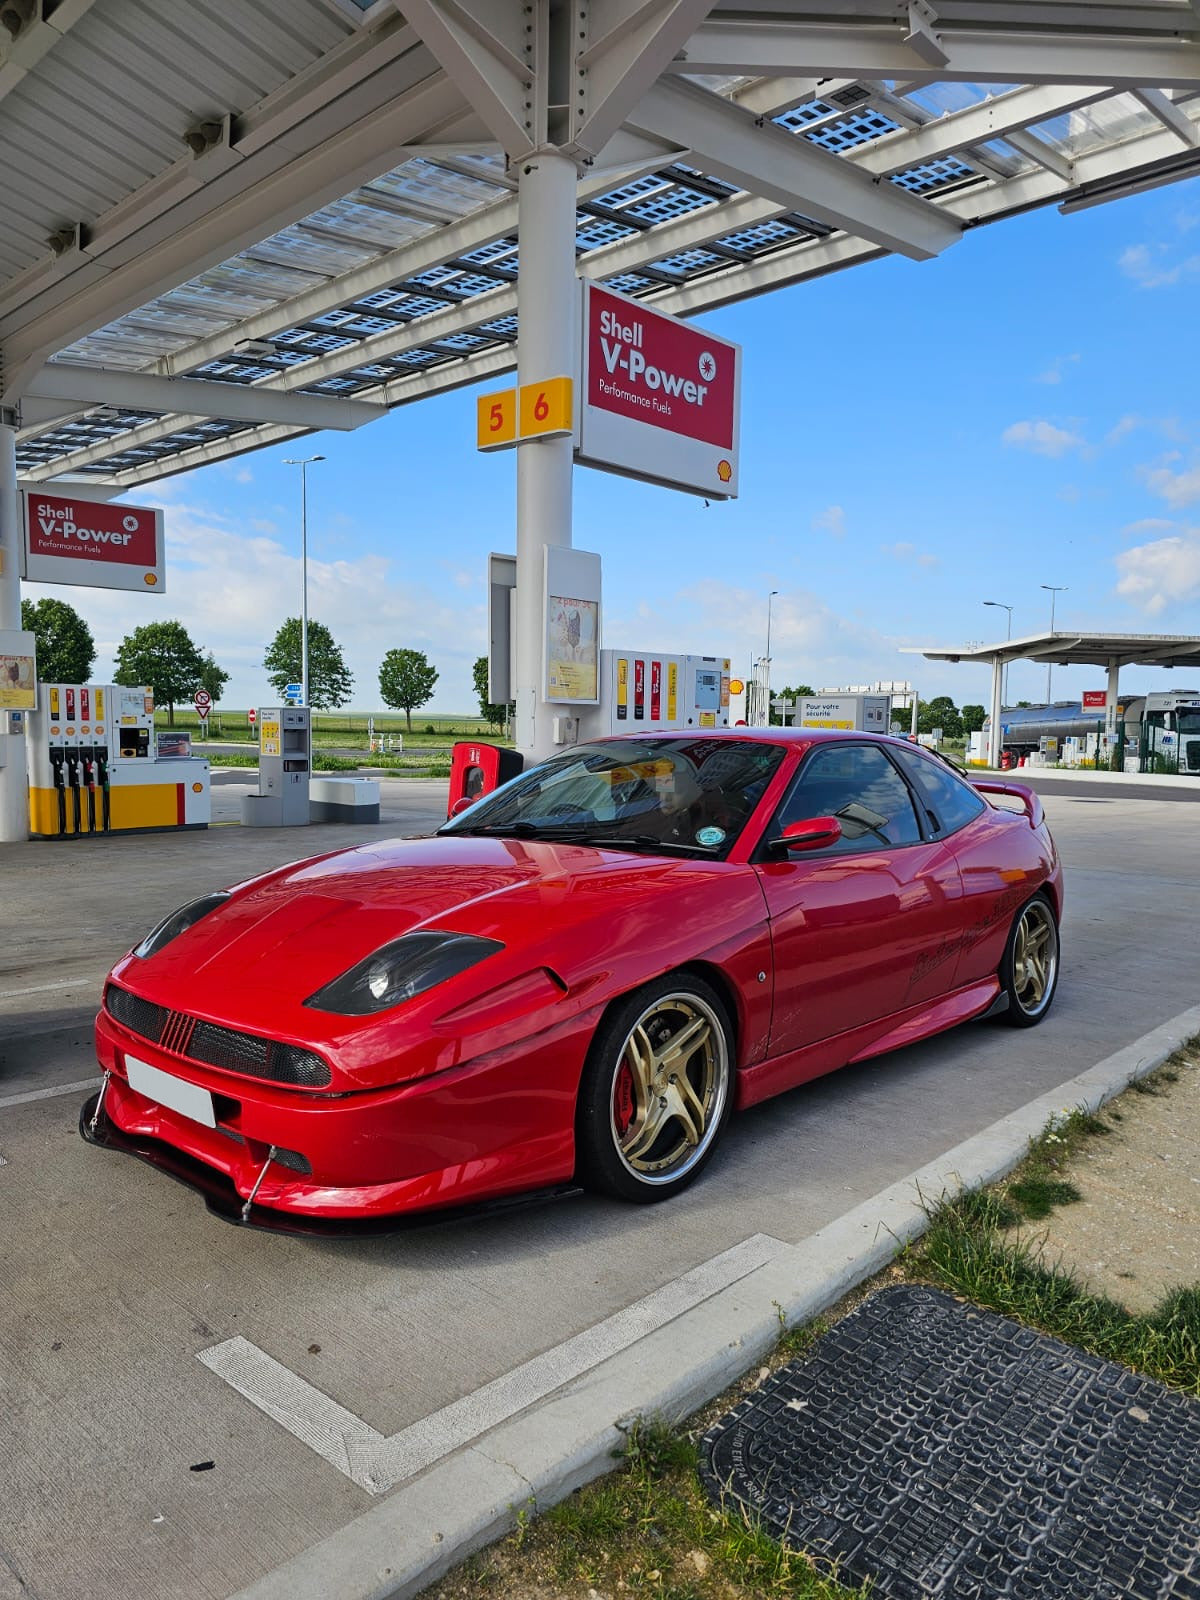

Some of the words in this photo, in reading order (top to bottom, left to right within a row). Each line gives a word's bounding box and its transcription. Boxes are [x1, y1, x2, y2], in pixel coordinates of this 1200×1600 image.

[600, 310, 643, 348] Shell
[600, 336, 708, 406] V-Power
[489, 404, 504, 431] 5
[533, 392, 549, 421] 6
[599, 378, 651, 408] Performance
[652, 398, 672, 415] Fuels
[38, 504, 74, 520] Shell
[38, 518, 132, 545] V-Power
[38, 539, 83, 551] Performance
[84, 544, 101, 553] Fuels
[806, 709, 831, 717] sécurité
